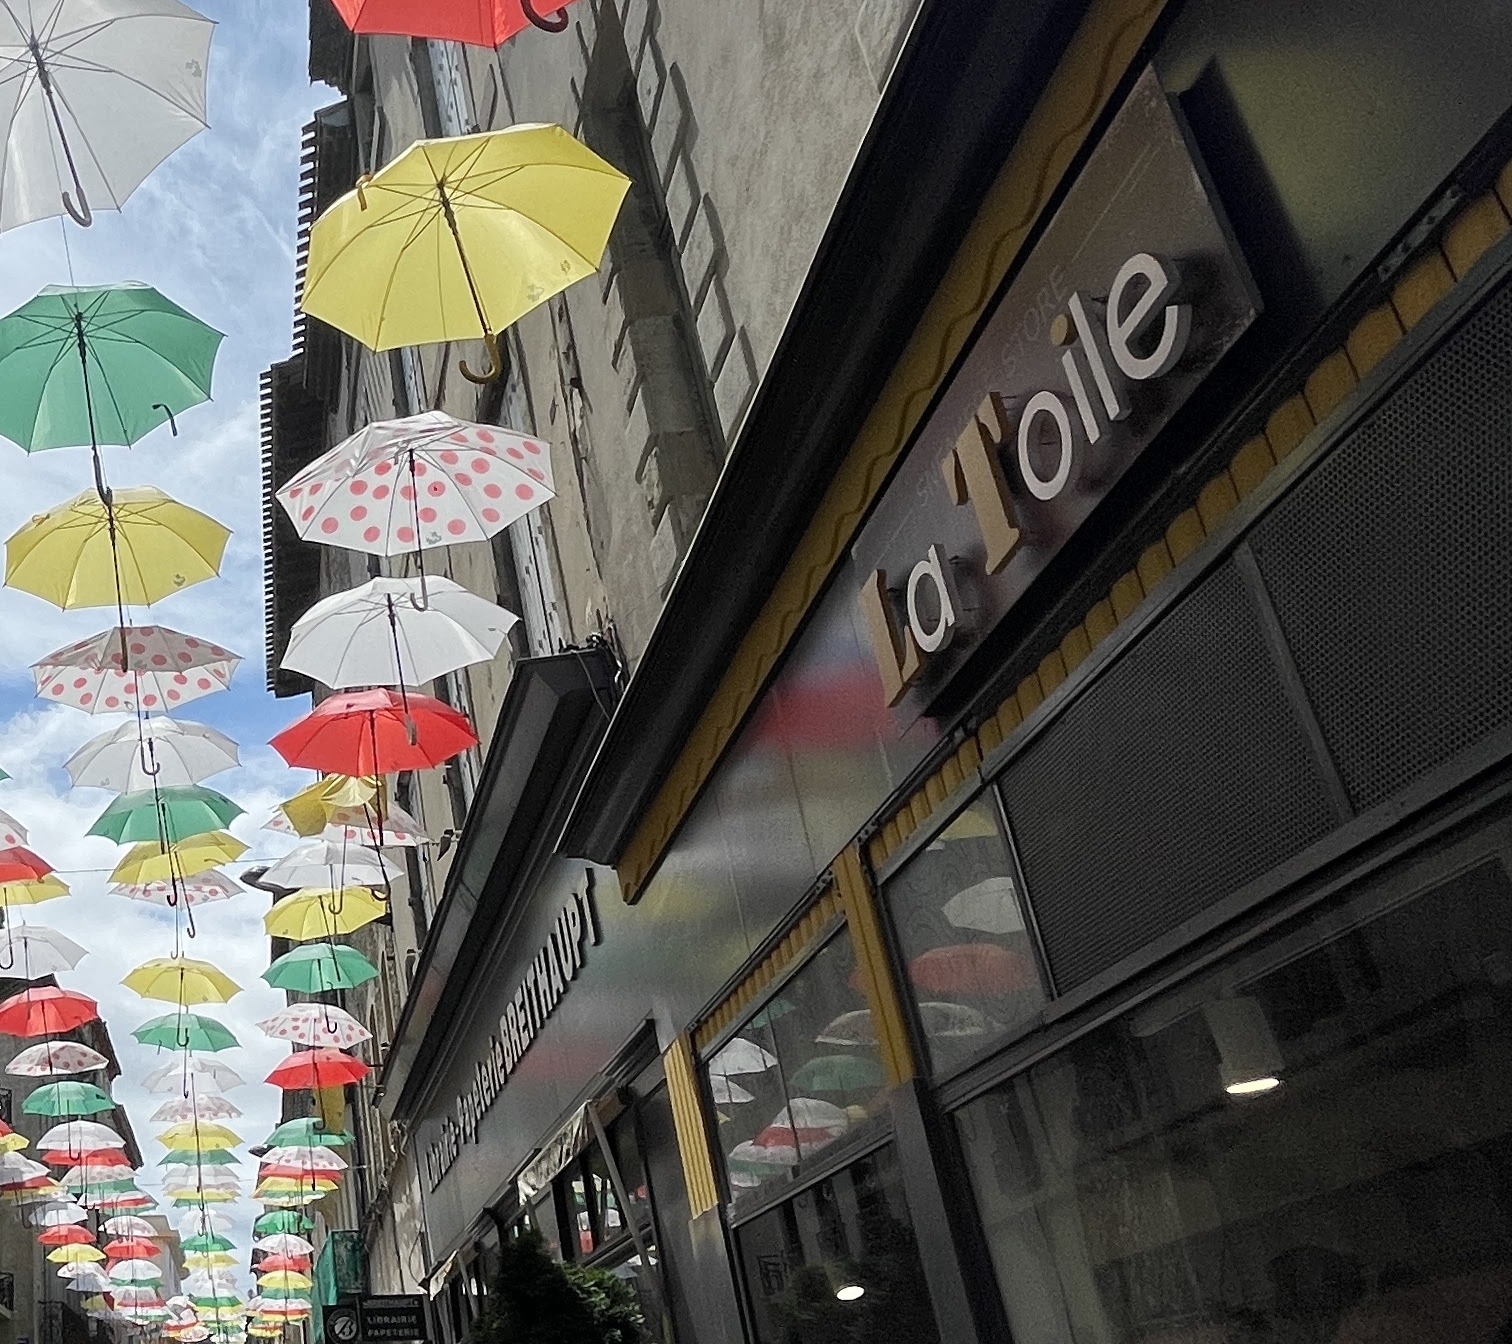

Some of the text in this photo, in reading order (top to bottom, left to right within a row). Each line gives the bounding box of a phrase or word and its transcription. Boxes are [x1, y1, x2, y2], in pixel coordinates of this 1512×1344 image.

[1001, 263, 1068, 378] STORE
[859, 252, 1192, 707] La Toile
[500, 868, 599, 1075] BREITHAUPT
